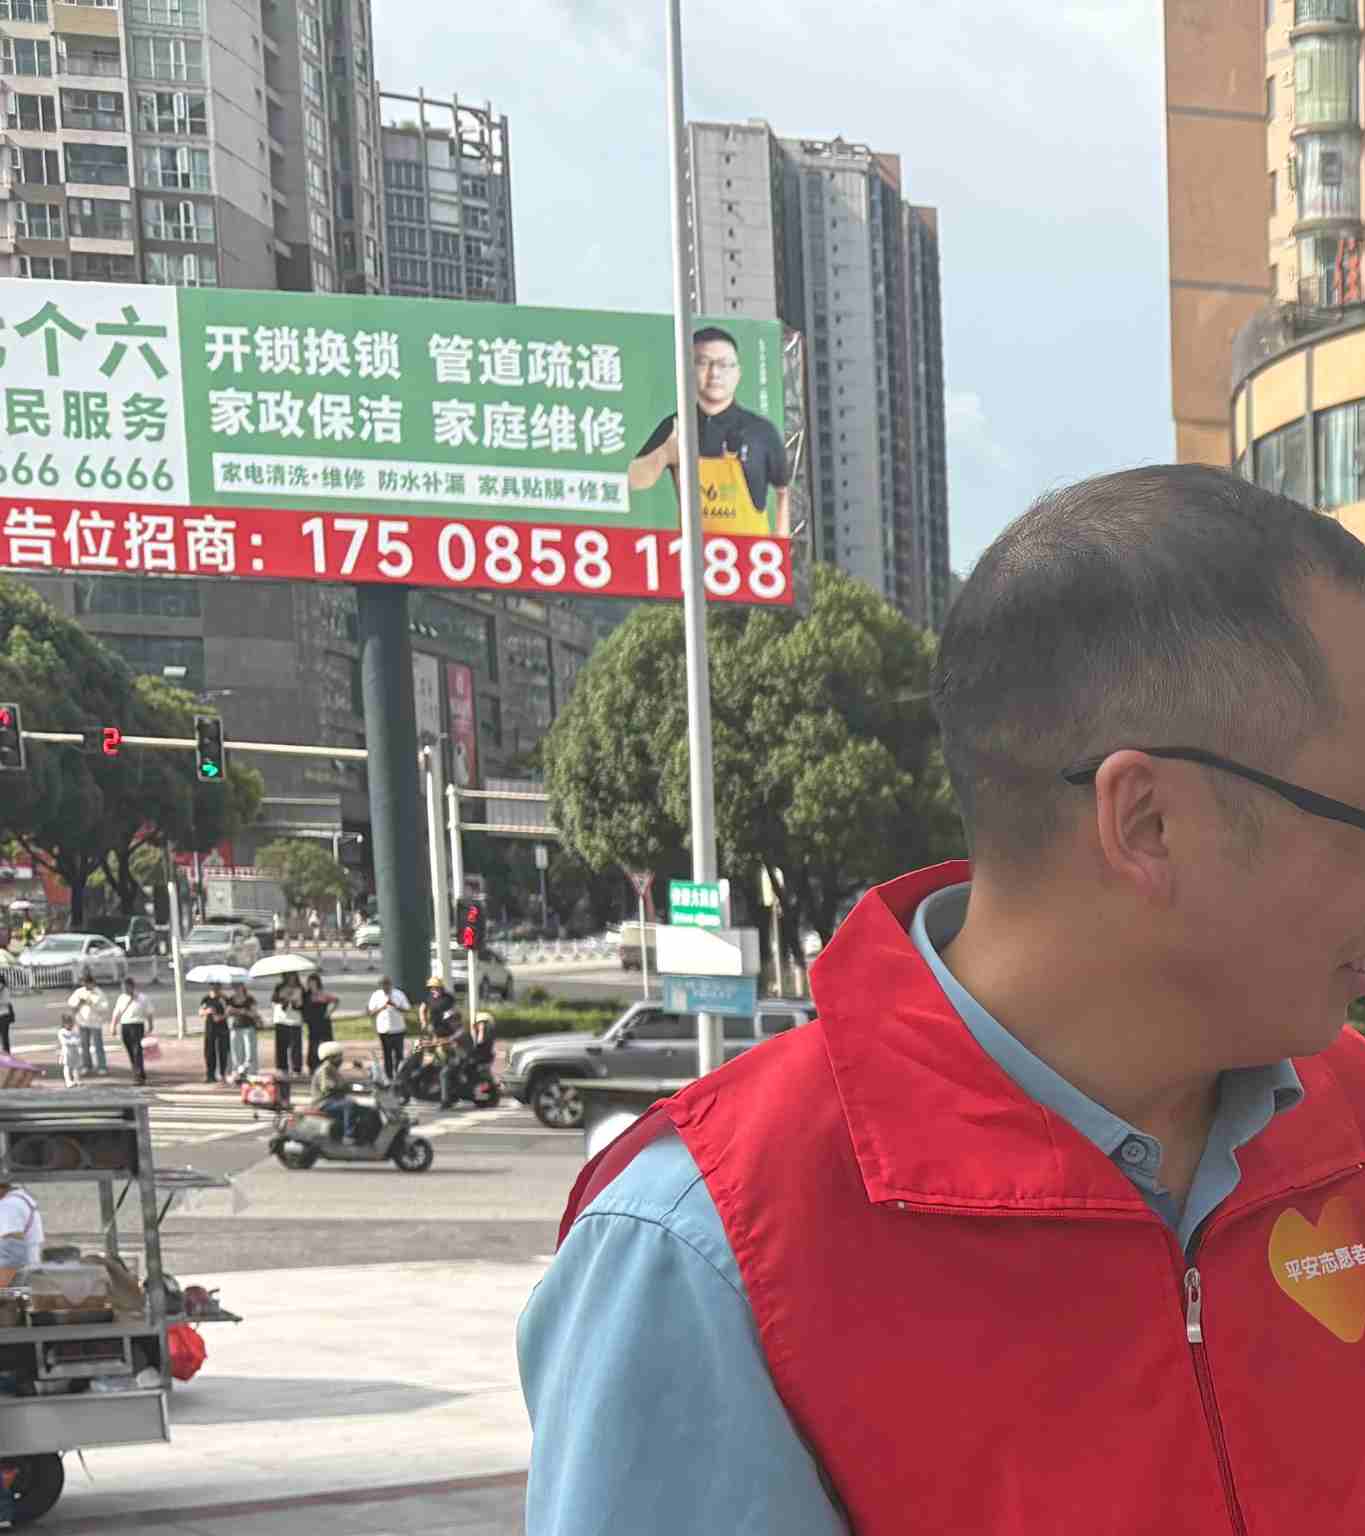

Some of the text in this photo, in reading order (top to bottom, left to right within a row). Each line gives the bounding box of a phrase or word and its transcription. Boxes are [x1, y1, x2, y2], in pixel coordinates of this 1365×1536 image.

[0, 300, 168, 379] 个六
[204, 325, 624, 392] 开锁换锁 管道疏通
[5, 387, 168, 442] 民服务
[208, 387, 627, 455] 家政保洁 家庭维修
[75, 457, 174, 492] 6666
[377, 469, 464, 496] 防水补漏
[301, 517, 414, 578] 175
[437, 523, 612, 588] 0858
